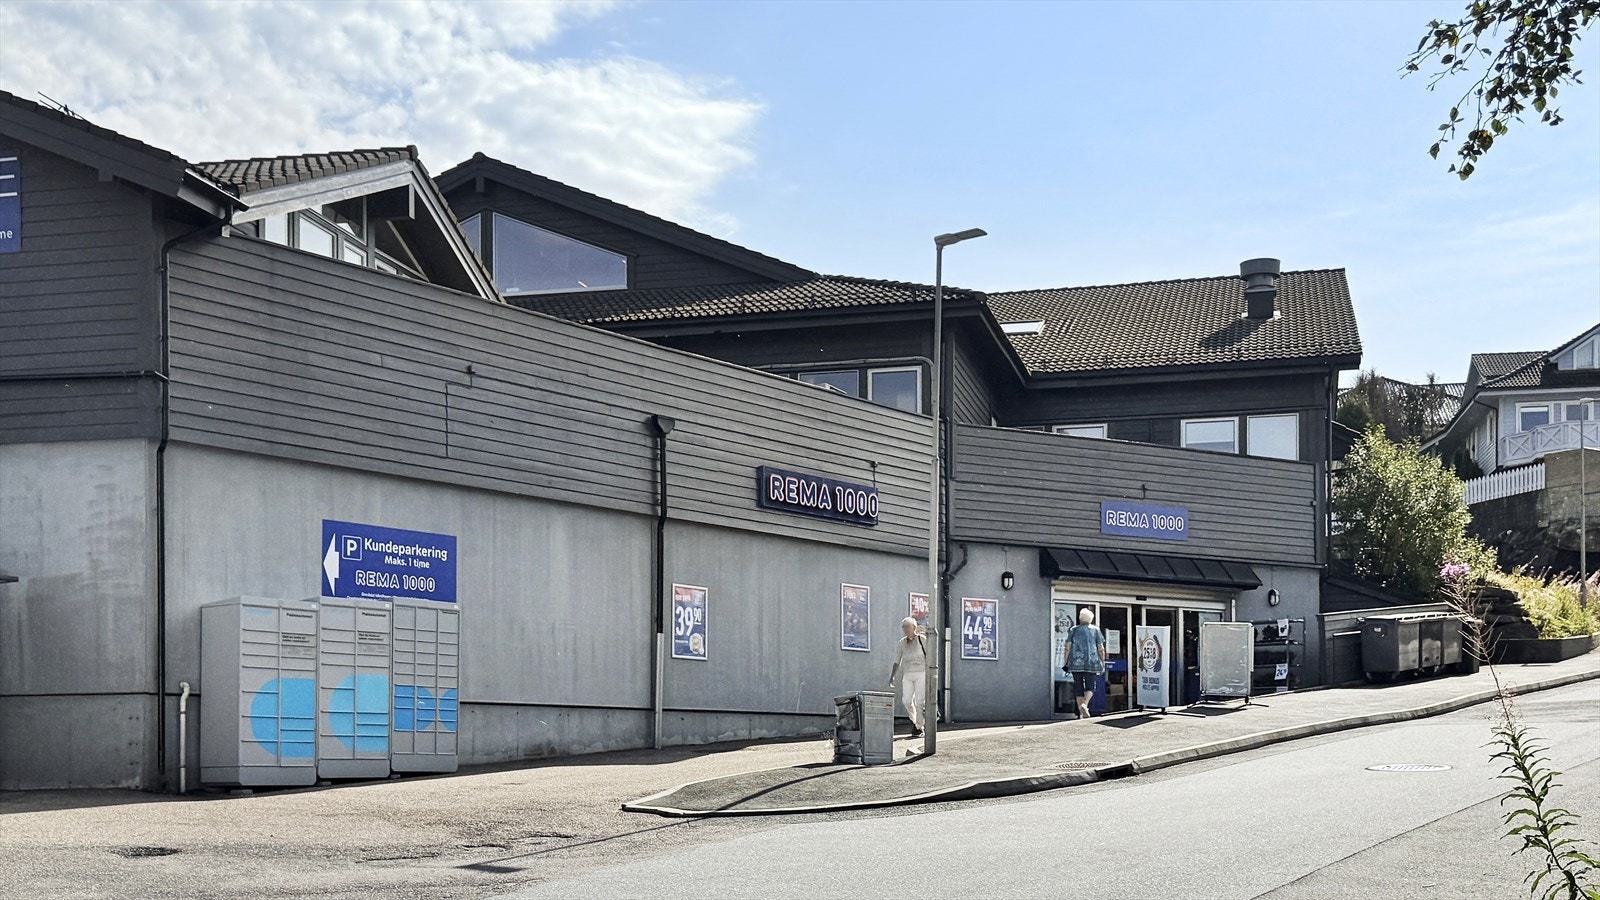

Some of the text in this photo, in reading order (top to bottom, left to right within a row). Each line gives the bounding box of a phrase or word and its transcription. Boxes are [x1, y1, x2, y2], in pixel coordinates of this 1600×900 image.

[769, 474, 879, 517] REMA 1000
[1106, 510, 1184, 532] REMA 1000
[346, 538, 448, 562] P Kundeparkering
[384, 555, 430, 569] Maks. 1 time
[355, 570, 436, 593] REMA 1000
